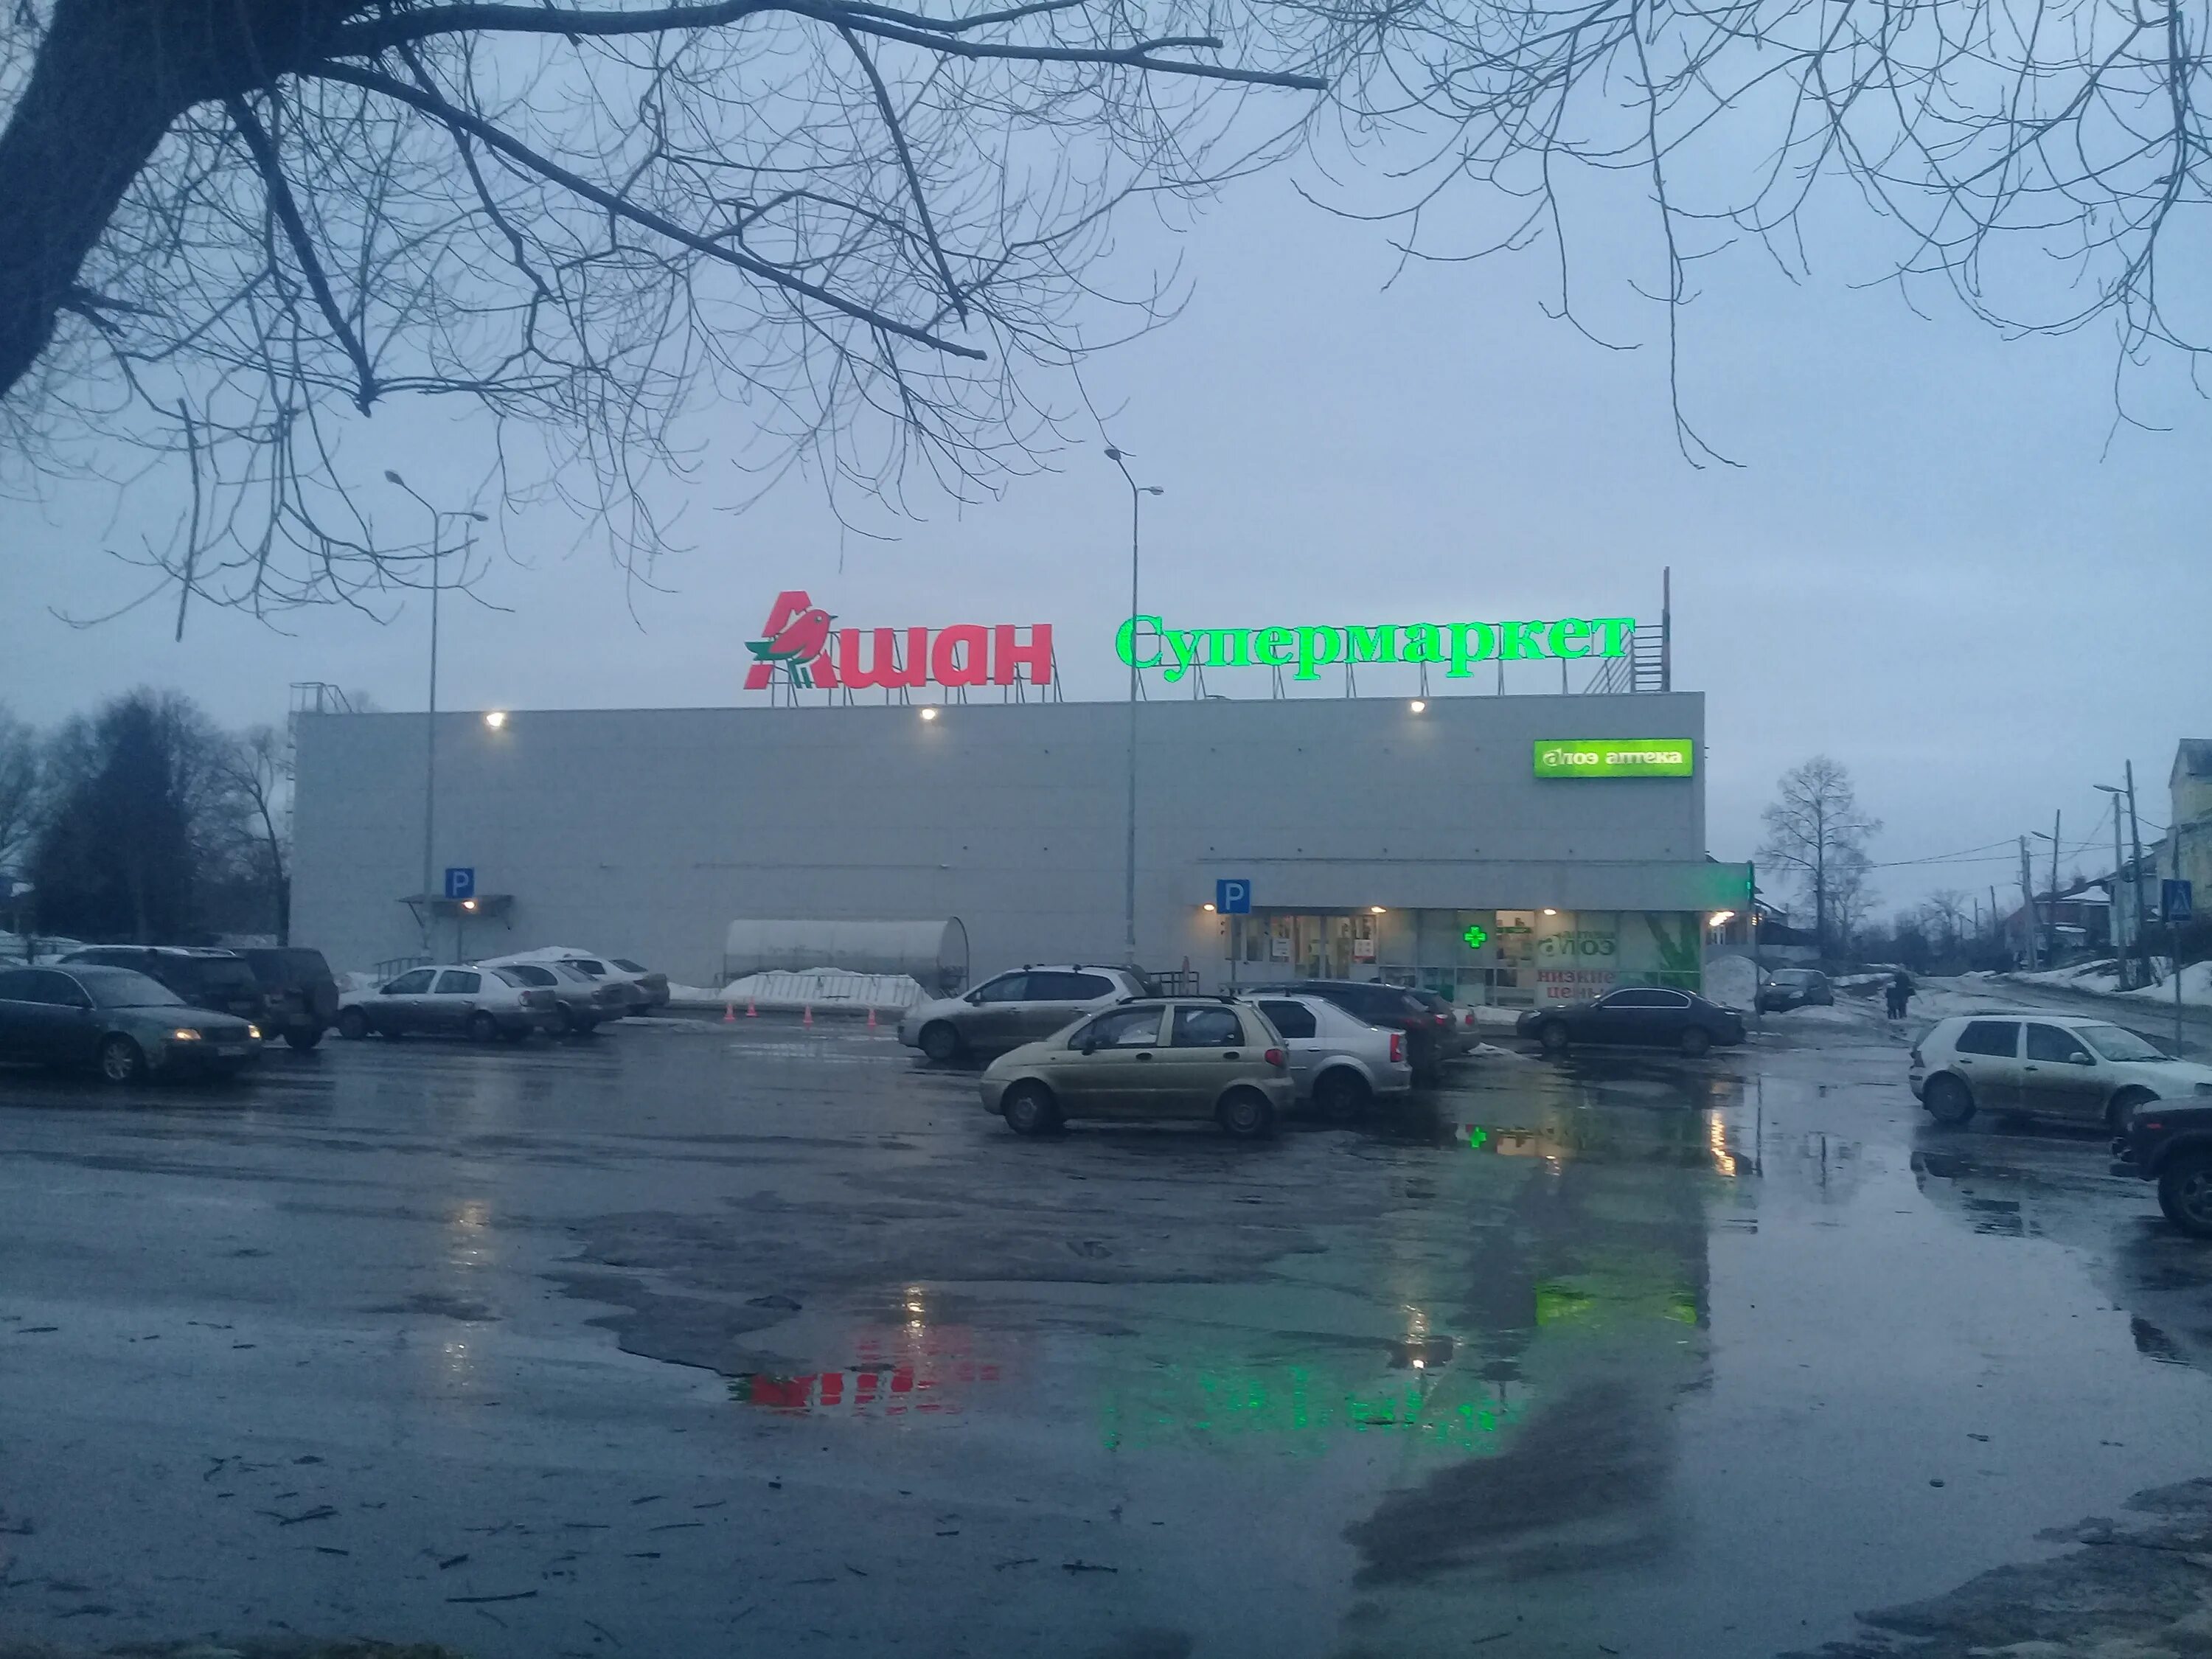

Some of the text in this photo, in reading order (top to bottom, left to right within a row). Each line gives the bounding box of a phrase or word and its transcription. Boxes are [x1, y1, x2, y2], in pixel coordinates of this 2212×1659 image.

[743, 590, 1052, 690] Ашан
[1116, 615, 1635, 683] Супермаркет
[1605, 751, 1683, 765] аптека
